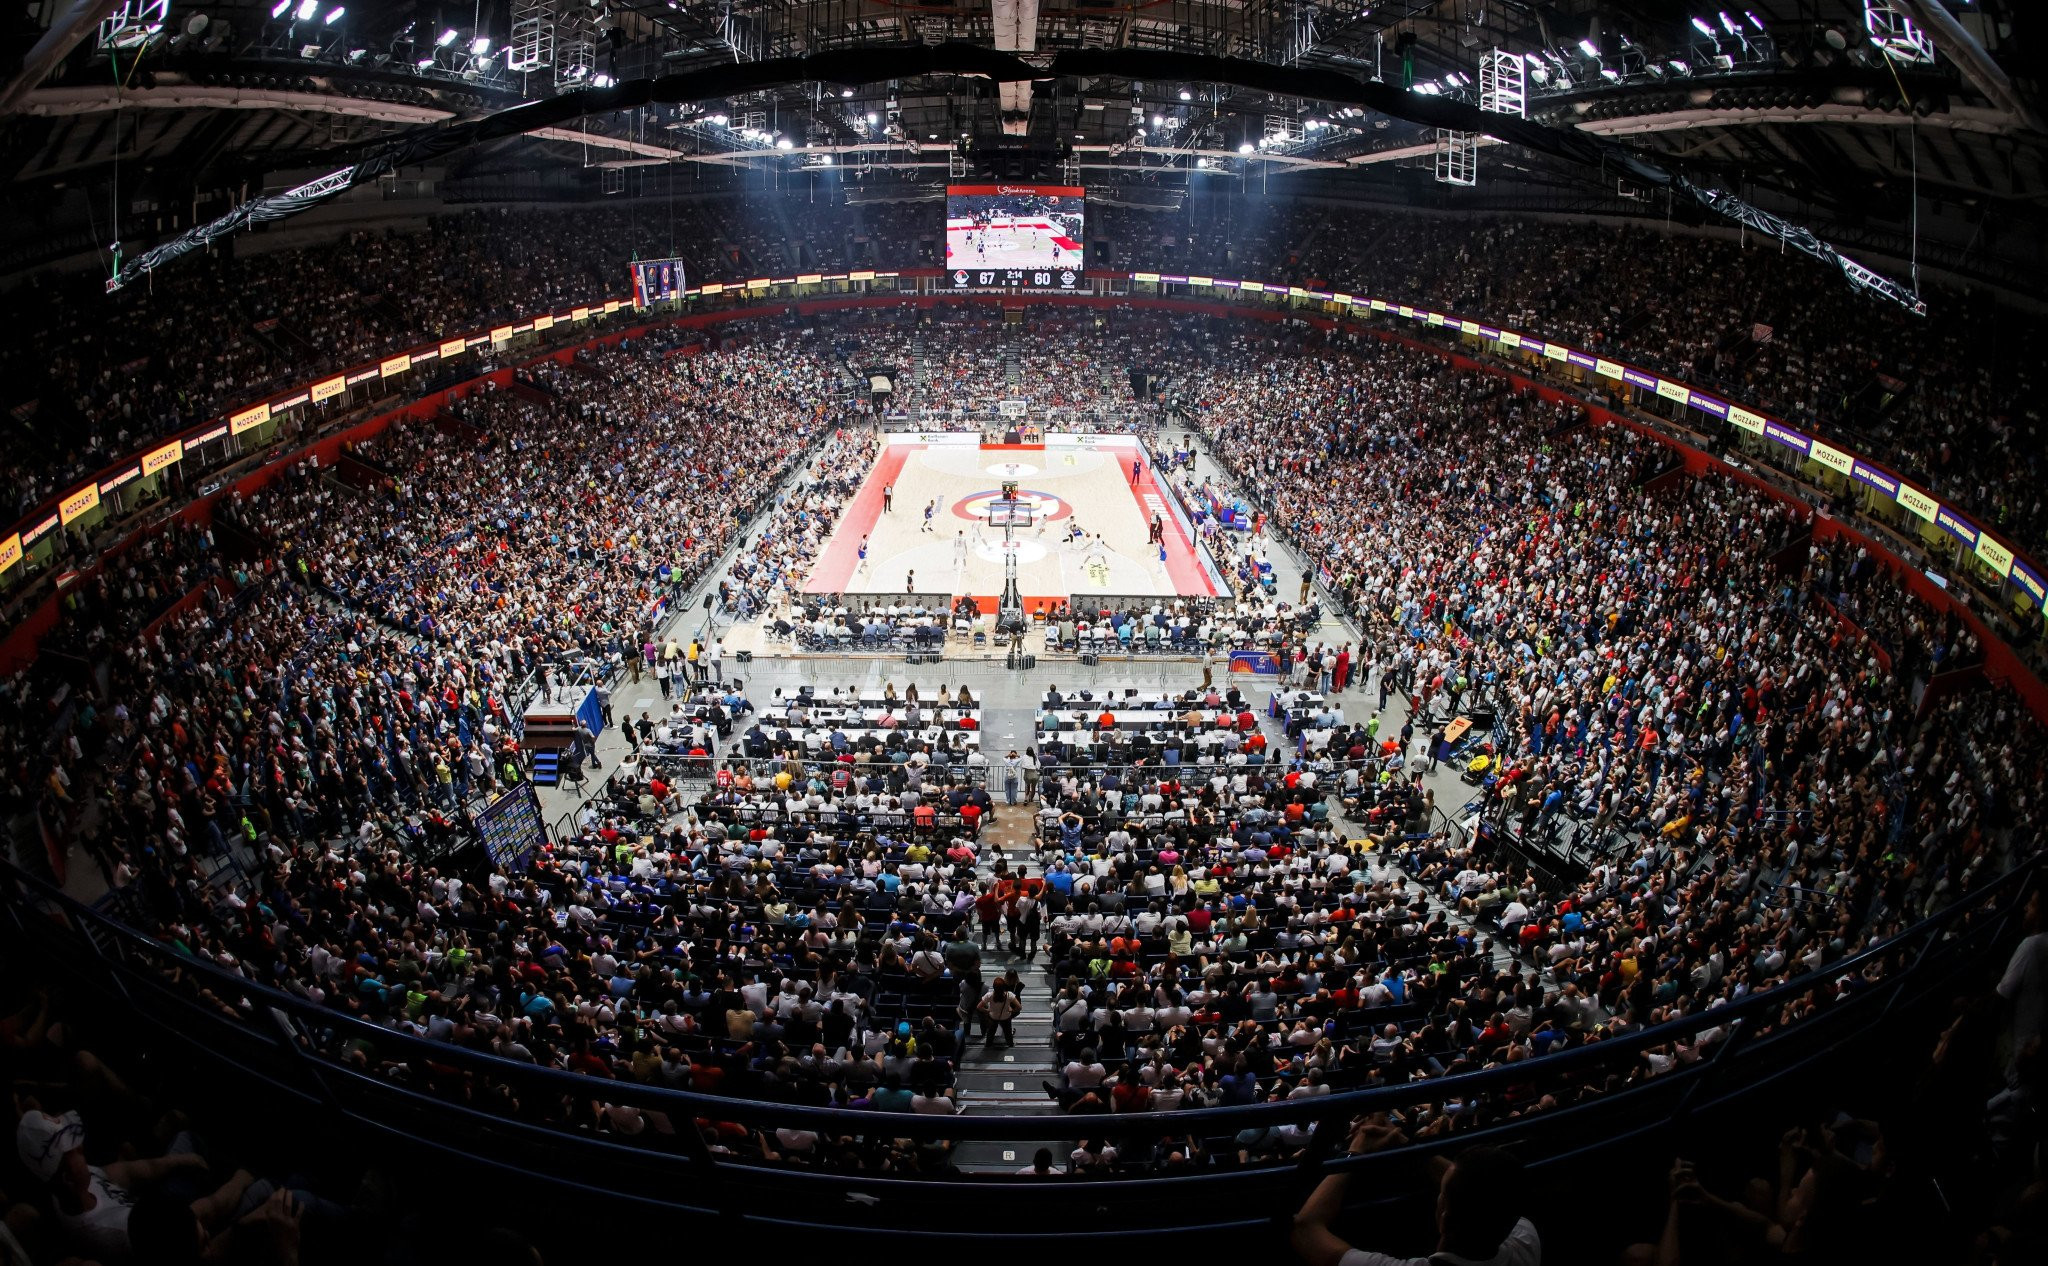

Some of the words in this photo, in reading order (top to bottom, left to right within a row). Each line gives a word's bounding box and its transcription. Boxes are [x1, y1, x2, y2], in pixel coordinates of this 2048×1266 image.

[980, 272, 995, 285] 67
[1007, 270, 1022, 279] 2:14
[1034, 272, 1050, 285] 60
[1661, 386, 1684, 398] MOZZART
[1733, 412, 1759, 428] MOZZART
[1766, 426, 1780, 436] BUDI
[1780, 431, 1808, 449] POBEDNIK
[1816, 448, 1846, 468] MOZZART
[1854, 465, 1869, 479] BUDI
[1903, 493, 1932, 513] MOZZART
[1982, 542, 2007, 567] MOZZART
[720, 776, 728, 786] 14
